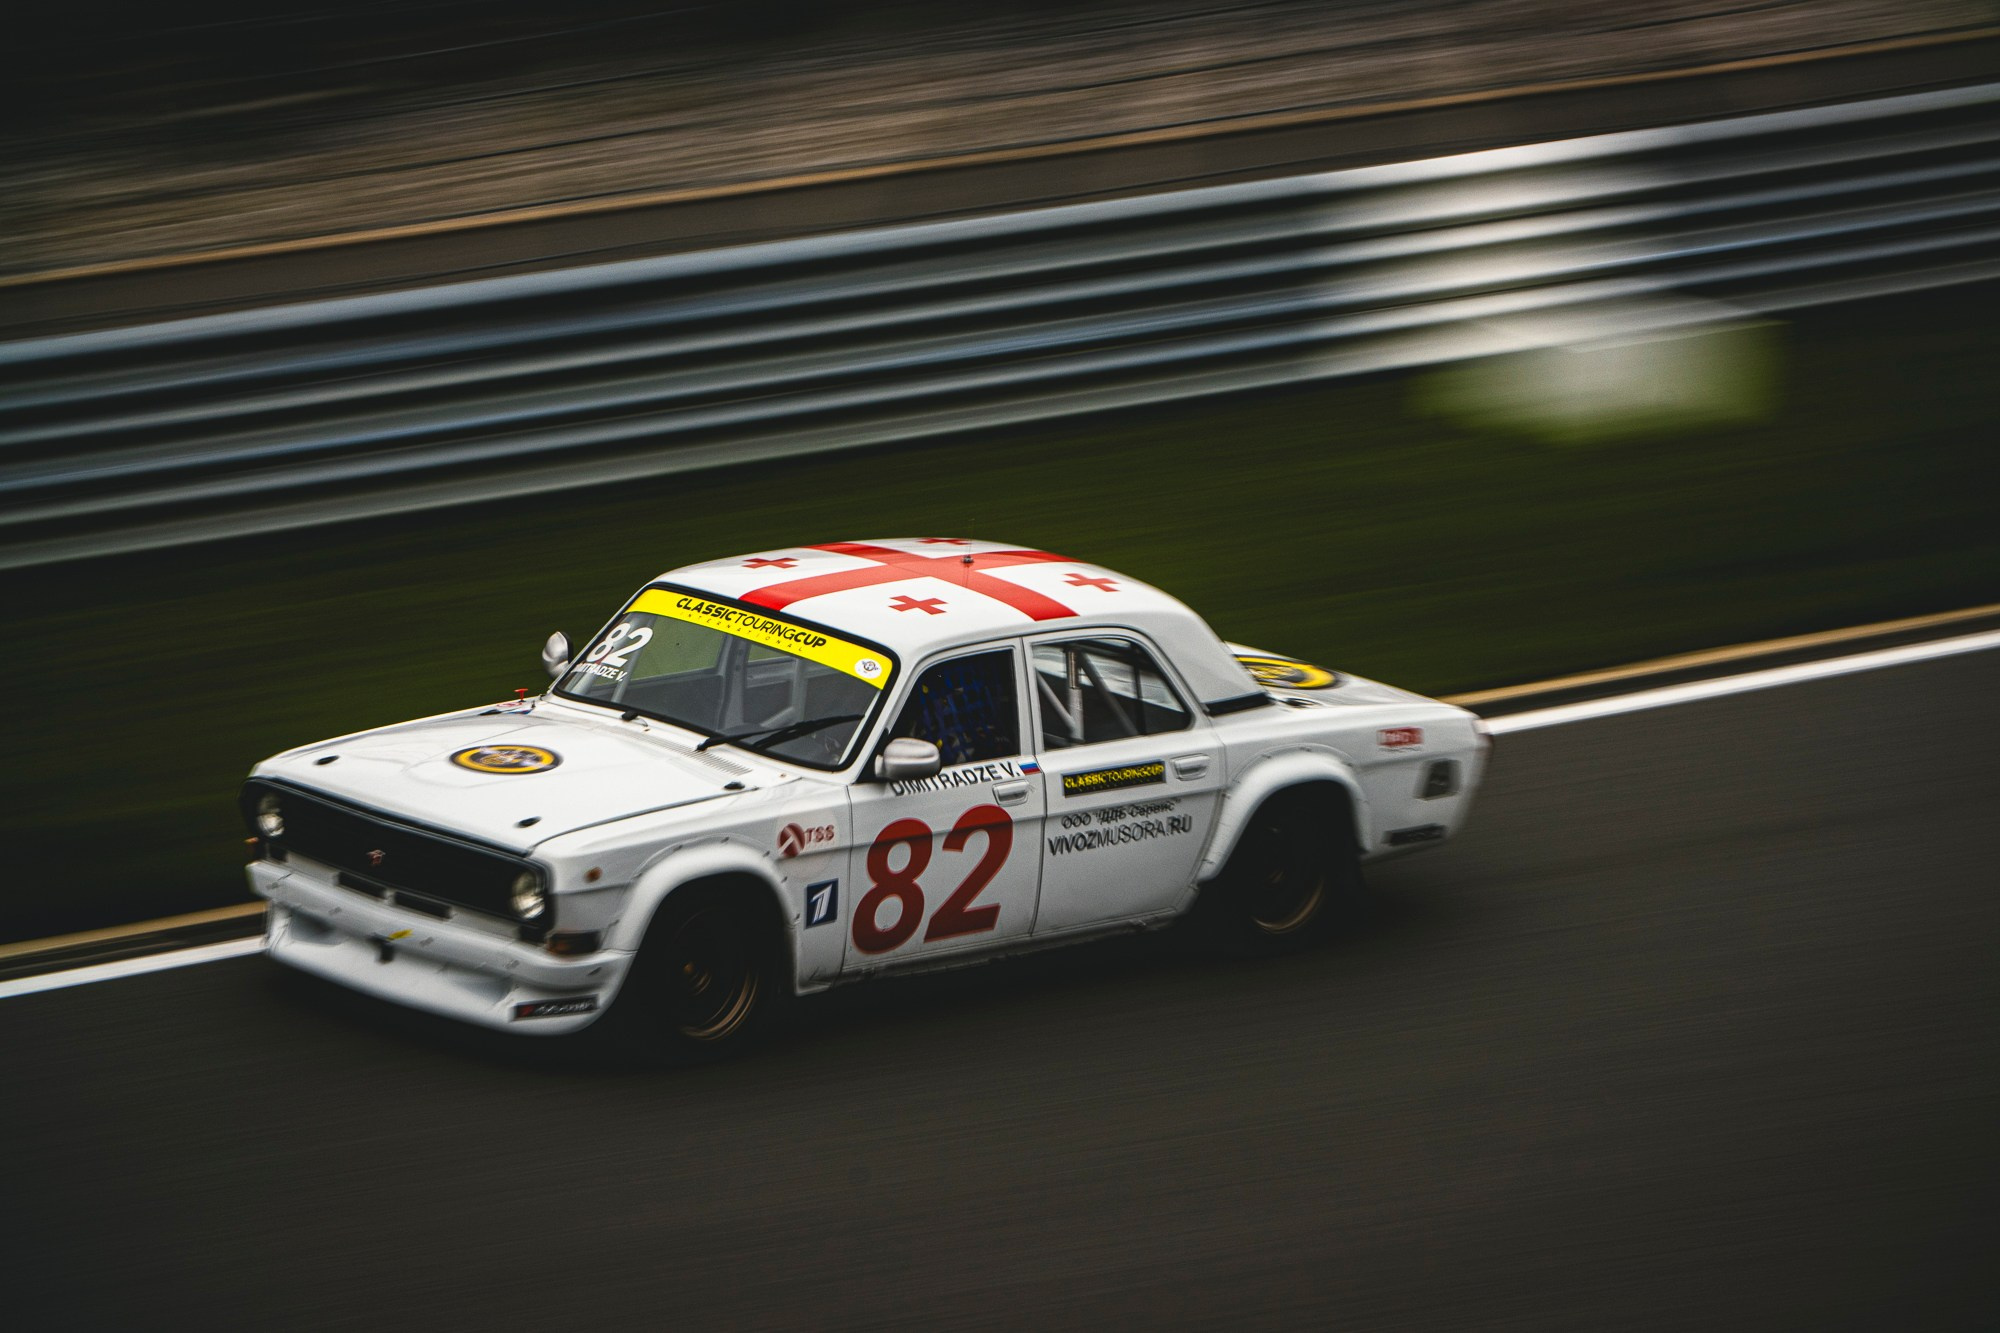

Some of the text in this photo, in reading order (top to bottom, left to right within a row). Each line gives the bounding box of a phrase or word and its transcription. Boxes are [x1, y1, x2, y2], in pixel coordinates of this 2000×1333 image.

[586, 622, 653, 668] 82
[676, 597, 827, 648] CLASSICTOURINGCUP
[1000, 760, 1021, 778] V.
[1047, 813, 1193, 856] VIVOZMUSORA.RU
[851, 803, 1014, 955] 82
